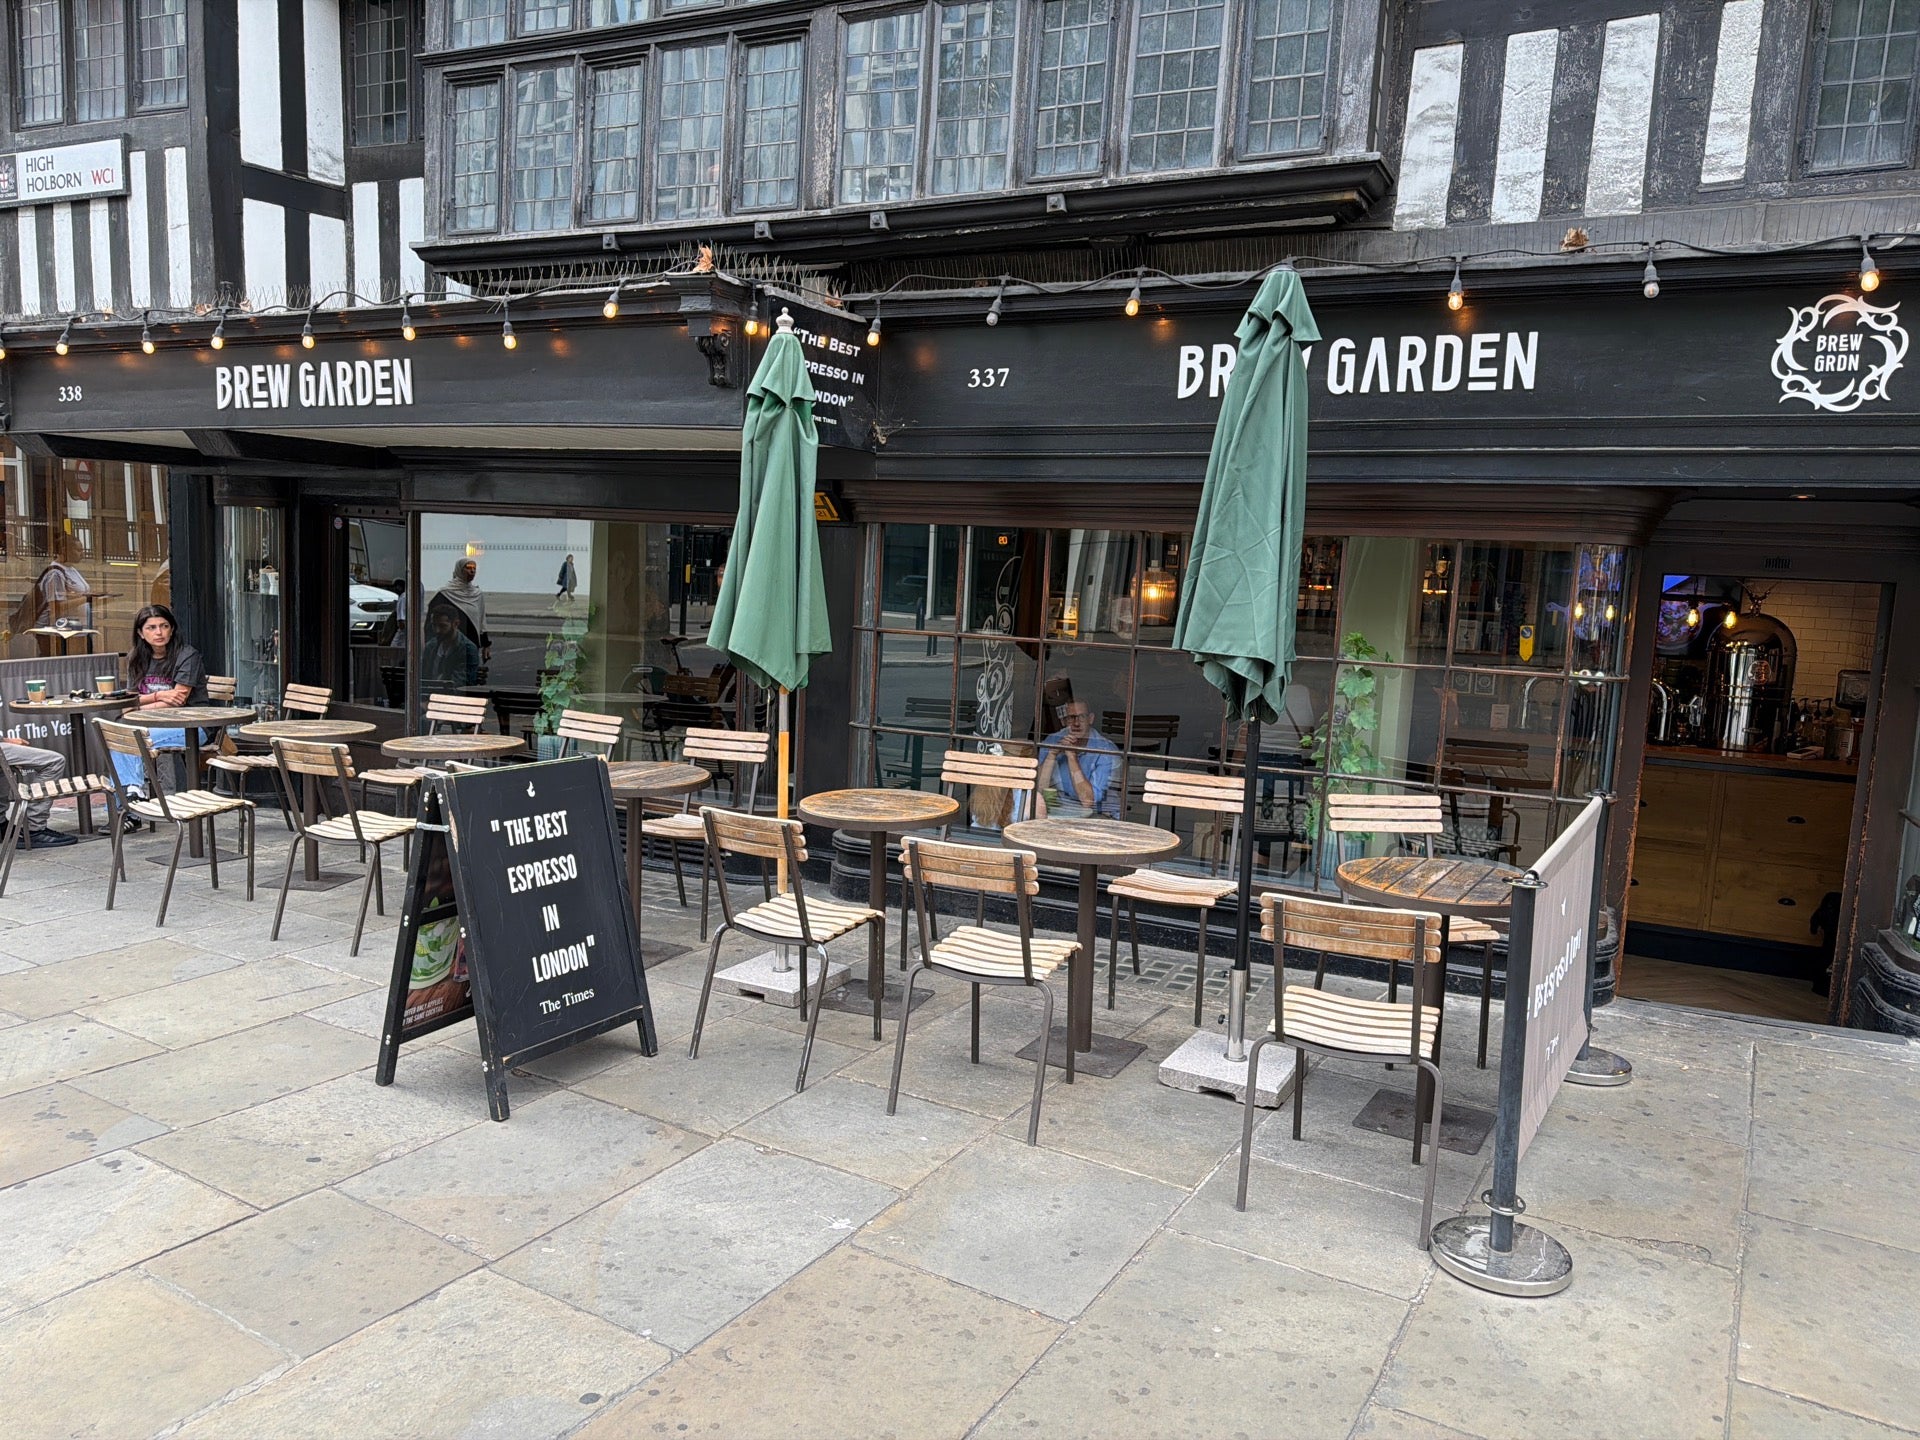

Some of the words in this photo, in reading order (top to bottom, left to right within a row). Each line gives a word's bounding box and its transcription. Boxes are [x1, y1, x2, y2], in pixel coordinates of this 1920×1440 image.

[26, 155, 54, 173] HIGH
[27, 172, 82, 193] HOLBORN
[91, 168, 115, 185] WC1
[829, 338, 861, 357] BEST
[1816, 333, 1863, 352] BREW
[1327, 331, 1540, 396] GARDEN
[1814, 354, 1860, 373] GRDN
[216, 364, 291, 410] BREW
[299, 358, 414, 407] GARDEN
[852, 372, 865, 385] IN
[967, 367, 1011, 389] 337
[58, 386, 83, 402] 338
[24, 721, 48, 740] The
[534, 810, 569, 841] BEST
[507, 853, 578, 894] ESPRESSO
[542, 903, 561, 932] IN
[539, 1000, 562, 1015] The
[562, 987, 595, 1007] Times
